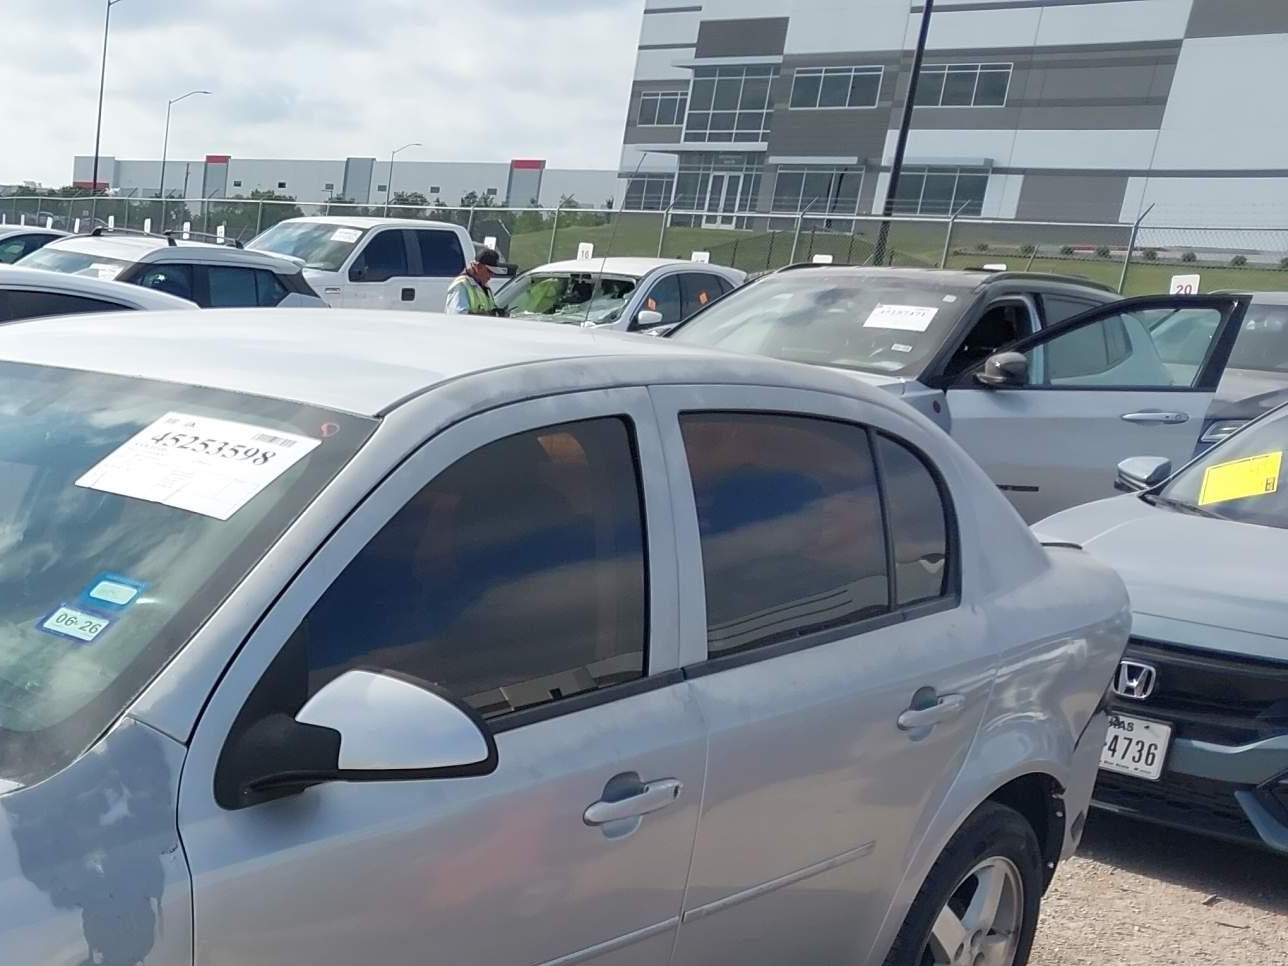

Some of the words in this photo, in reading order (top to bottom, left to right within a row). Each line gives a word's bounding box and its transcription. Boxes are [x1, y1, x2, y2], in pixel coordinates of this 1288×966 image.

[1176, 284, 1193, 295] 20
[150, 431, 277, 466] 45253598
[1107, 734, 1159, 767] 4736
